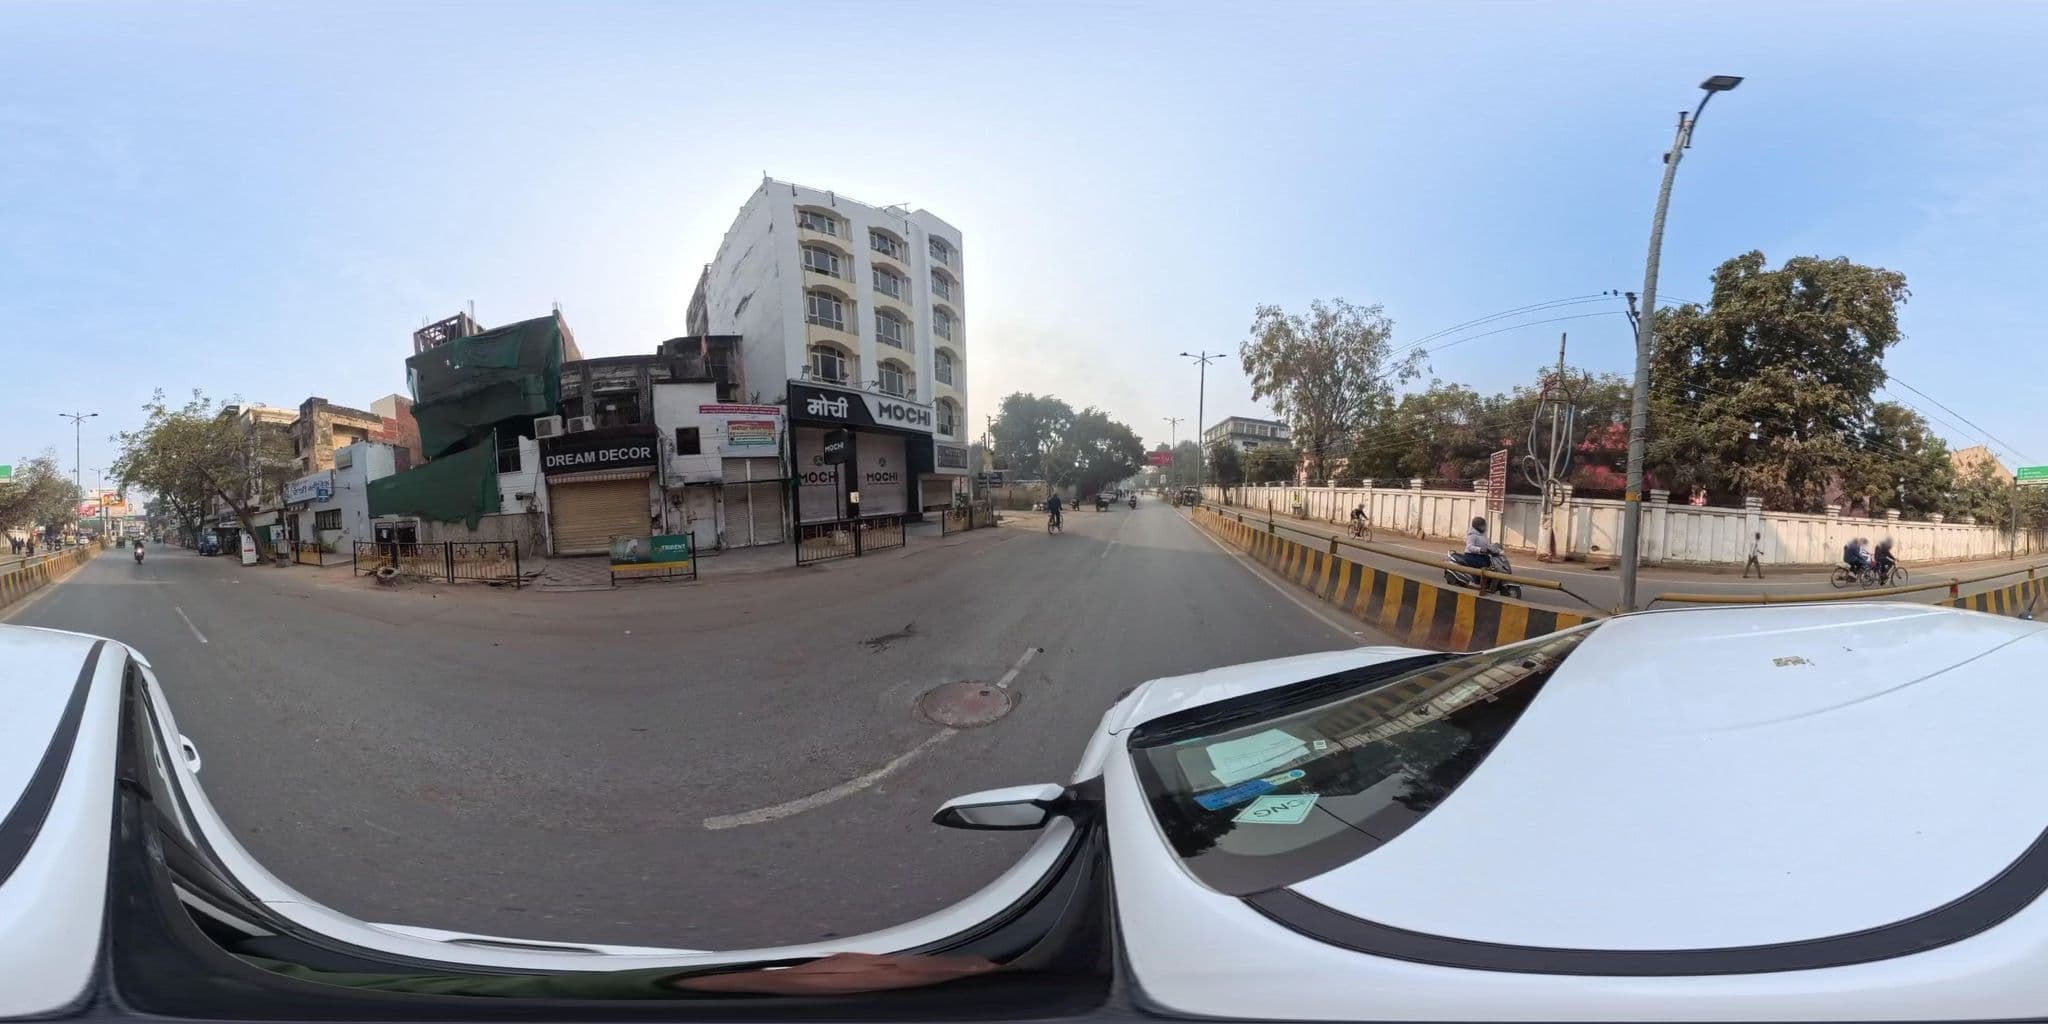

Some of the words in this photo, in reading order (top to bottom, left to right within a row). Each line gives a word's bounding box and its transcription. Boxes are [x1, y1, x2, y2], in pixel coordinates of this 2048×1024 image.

[806, 394, 848, 419] मोची
[878, 401, 931, 426] MOCHI
[824, 442, 845, 453] MOCHI
[546, 451, 596, 468] DREAM
[599, 447, 651, 462] DECOR
[866, 472, 898, 482] MOCHI
[661, 543, 686, 551] TRIDENT
[1253, 799, 1302, 818] CNG
